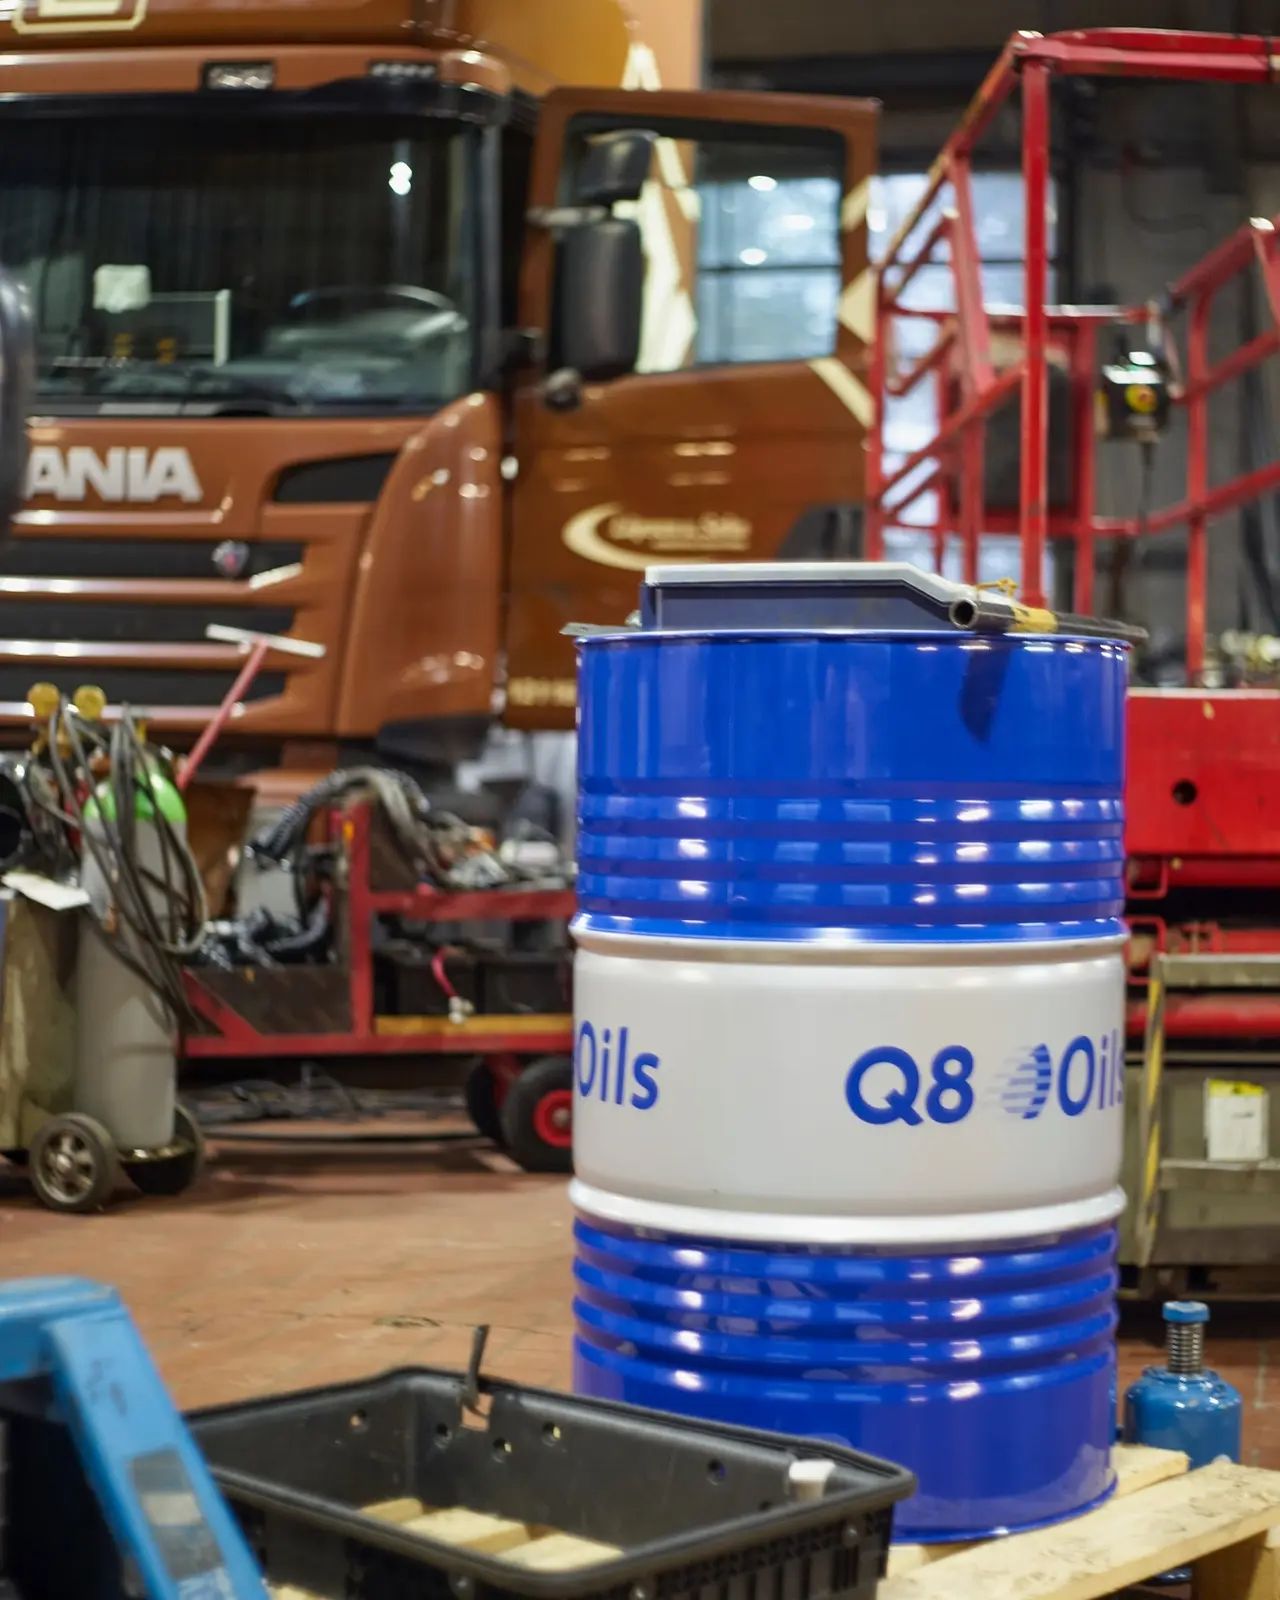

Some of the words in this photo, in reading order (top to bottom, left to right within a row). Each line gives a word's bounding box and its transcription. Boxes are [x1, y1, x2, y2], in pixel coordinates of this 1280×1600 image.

[24, 446, 203, 502] ANIA
[575, 1020, 660, 1110] Oils
[845, 1045, 975, 1126] Q8
